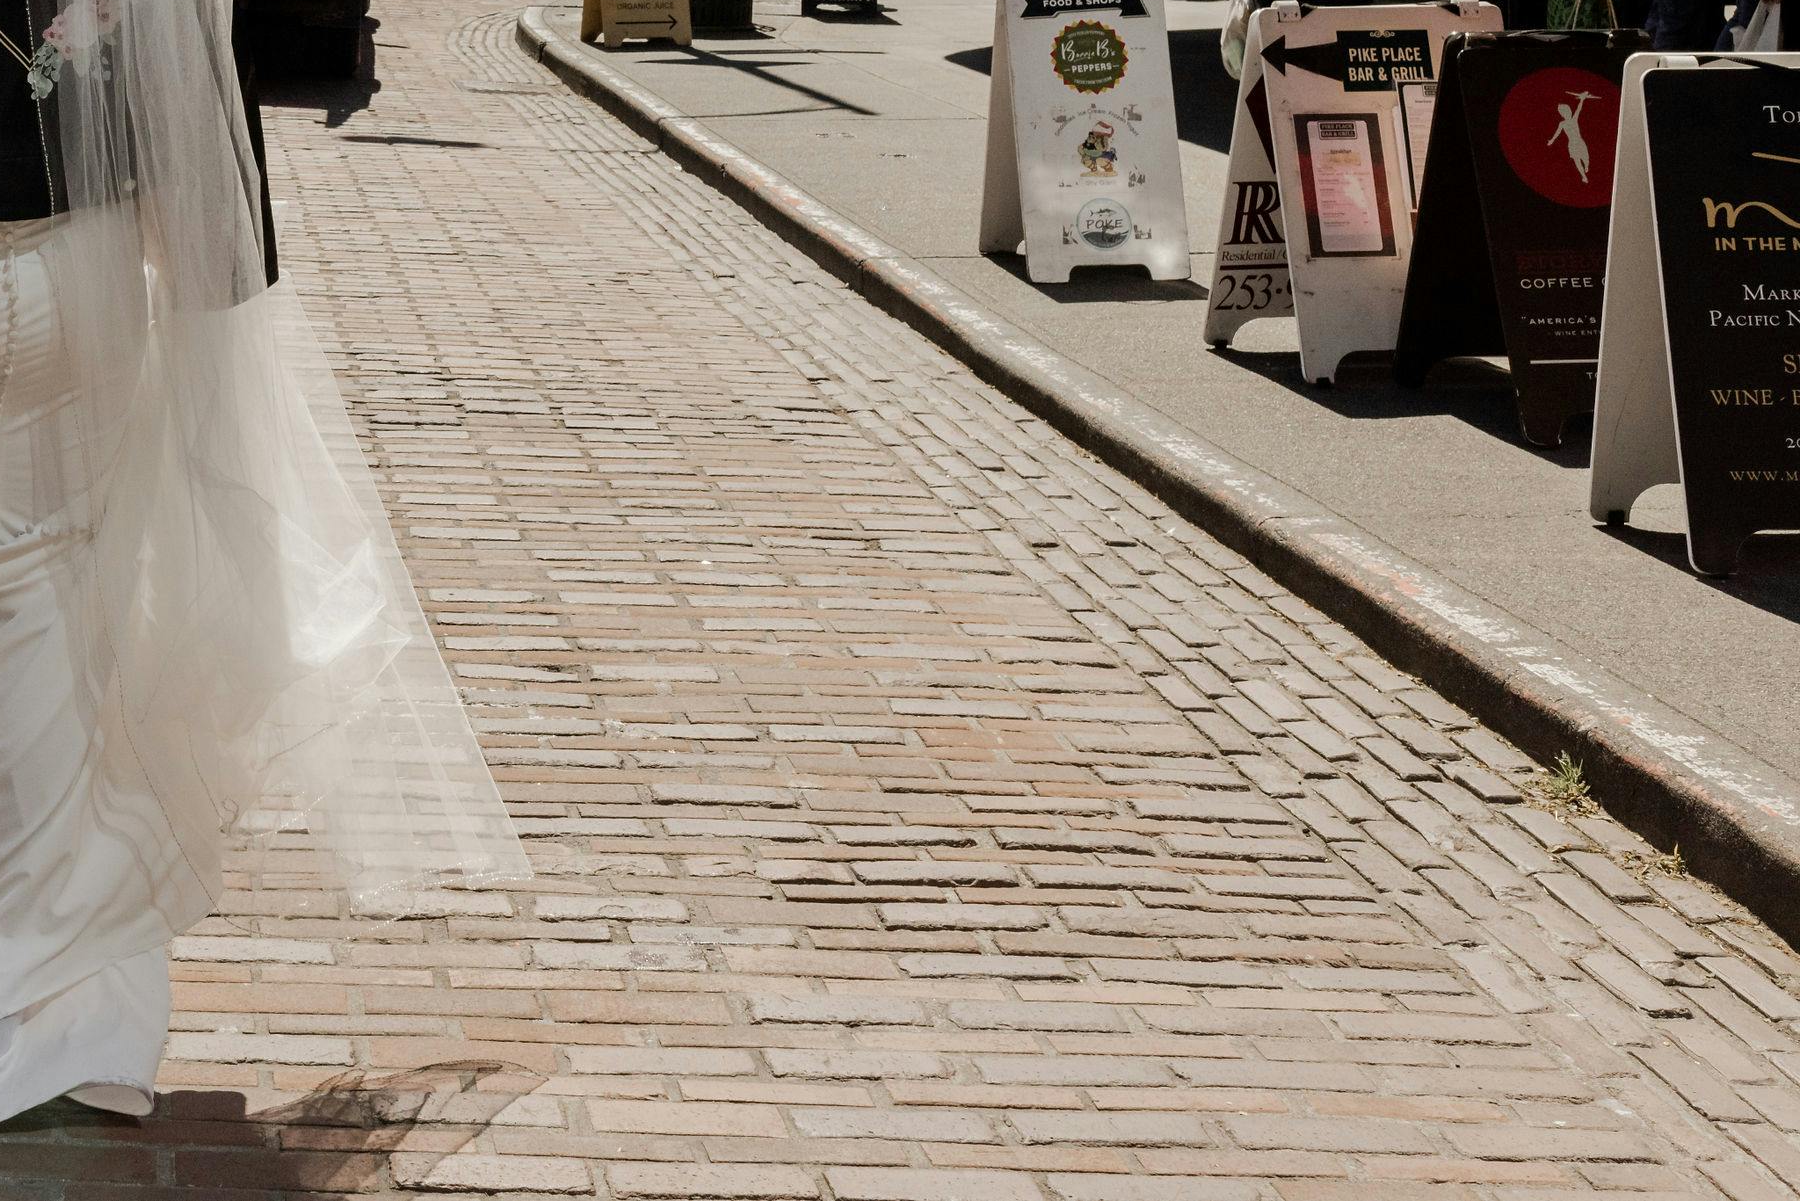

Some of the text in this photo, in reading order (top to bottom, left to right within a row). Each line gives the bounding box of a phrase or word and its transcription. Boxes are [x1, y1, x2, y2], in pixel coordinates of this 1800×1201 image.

[617, 1, 674, 10] ORGANIC JUICE
[1043, 0, 1073, 7] FOOD
[1348, 46, 1422, 62] PIKE PLACE
[1071, 62, 1112, 73] PEPPERS
[1348, 66, 1427, 82] BAR & GRILL
[1086, 219, 1123, 230] POKE
[1714, 237, 1737, 251] IN
[1742, 237, 1786, 251] THE
[1222, 249, 1276, 261] Residential
[1520, 277, 1594, 289] COFFEE
[1710, 389, 1774, 406] WINE
